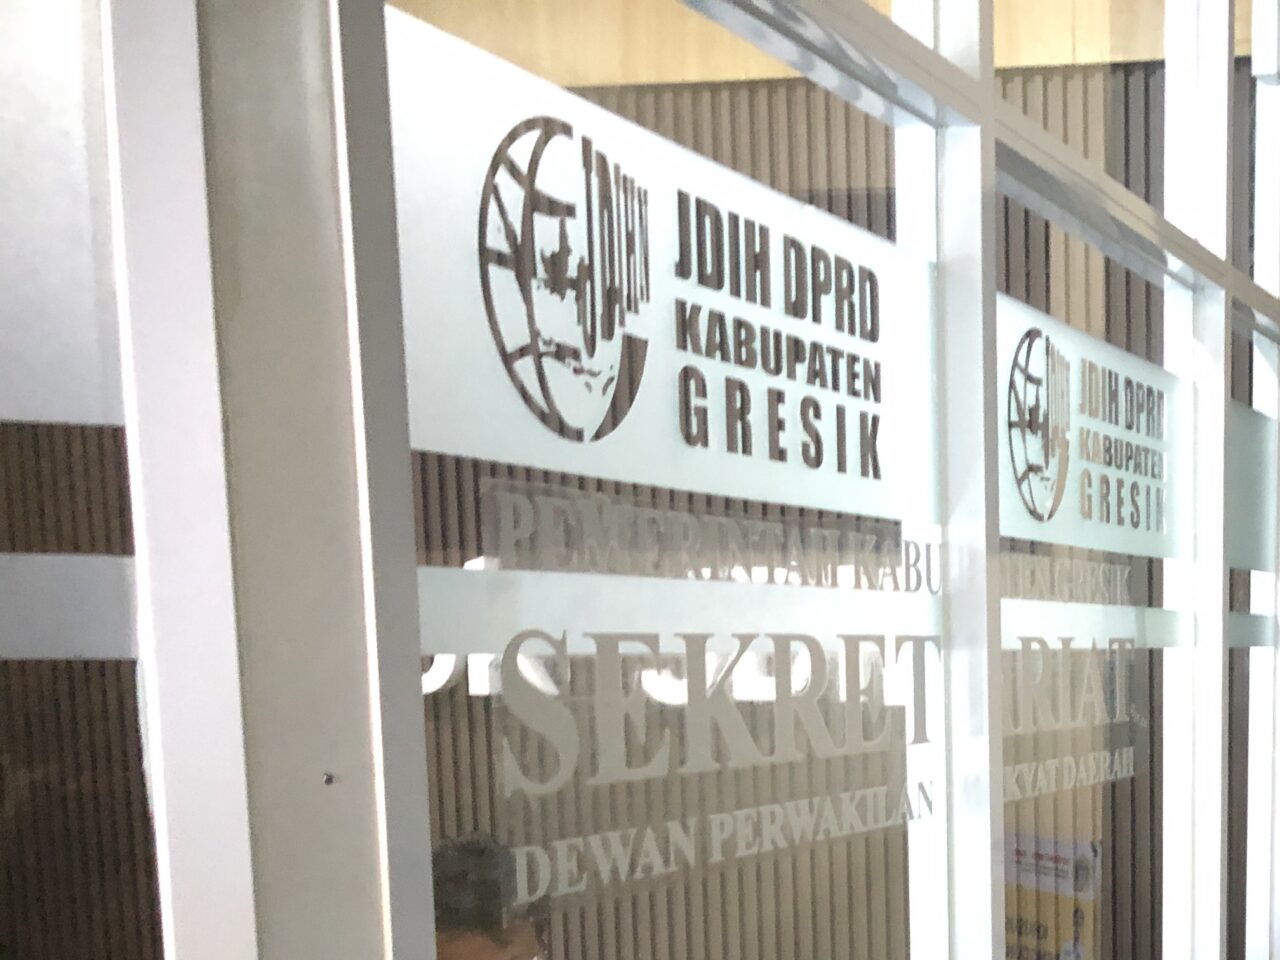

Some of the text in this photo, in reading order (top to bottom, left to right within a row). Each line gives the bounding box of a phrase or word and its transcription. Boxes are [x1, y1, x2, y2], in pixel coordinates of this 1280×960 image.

[675, 188, 880, 344] JDIH DPRD
[675, 297, 881, 404] KABUPATEN
[1079, 357, 1119, 426] JDIH
[677, 364, 882, 481] GRESIK
[513, 818, 696, 905] DEWAN
[709, 780, 933, 864] PERWAKILAN
